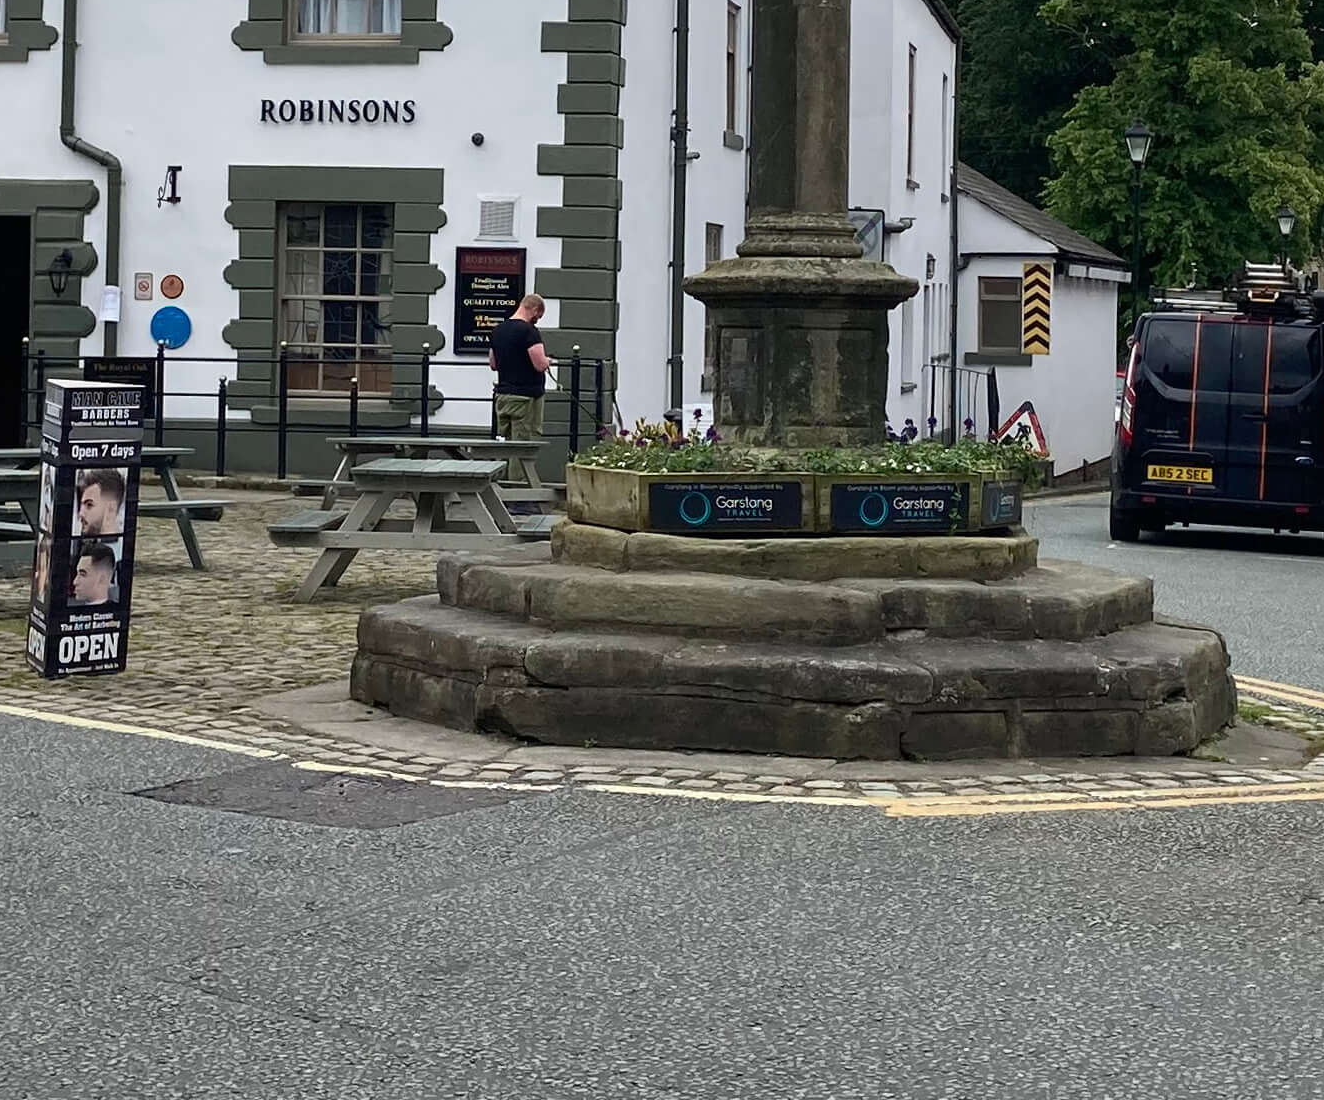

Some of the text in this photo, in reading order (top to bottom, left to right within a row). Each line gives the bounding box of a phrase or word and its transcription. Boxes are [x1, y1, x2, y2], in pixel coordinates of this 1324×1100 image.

[260, 99, 416, 124] ROBINSONS
[463, 298, 494, 307] QUALITY
[93, 363, 108, 372] The
[109, 363, 131, 373] Royal
[71, 390, 142, 407] MAN CAVE
[81, 408, 131, 420] BARBERS
[71, 445, 98, 461] Open
[101, 444, 110, 457] 7
[110, 443, 135, 460] days
[1185, 469, 1208, 481] SEC
[715, 495, 773, 512] Garstang
[893, 496, 945, 512] Garstang
[726, 509, 764, 517] TRAVEL
[901, 510, 935, 518] TRAVEL
[60, 623, 73, 632] The
[73, 623, 84, 631] Art
[58, 632, 120, 664] OPEN
